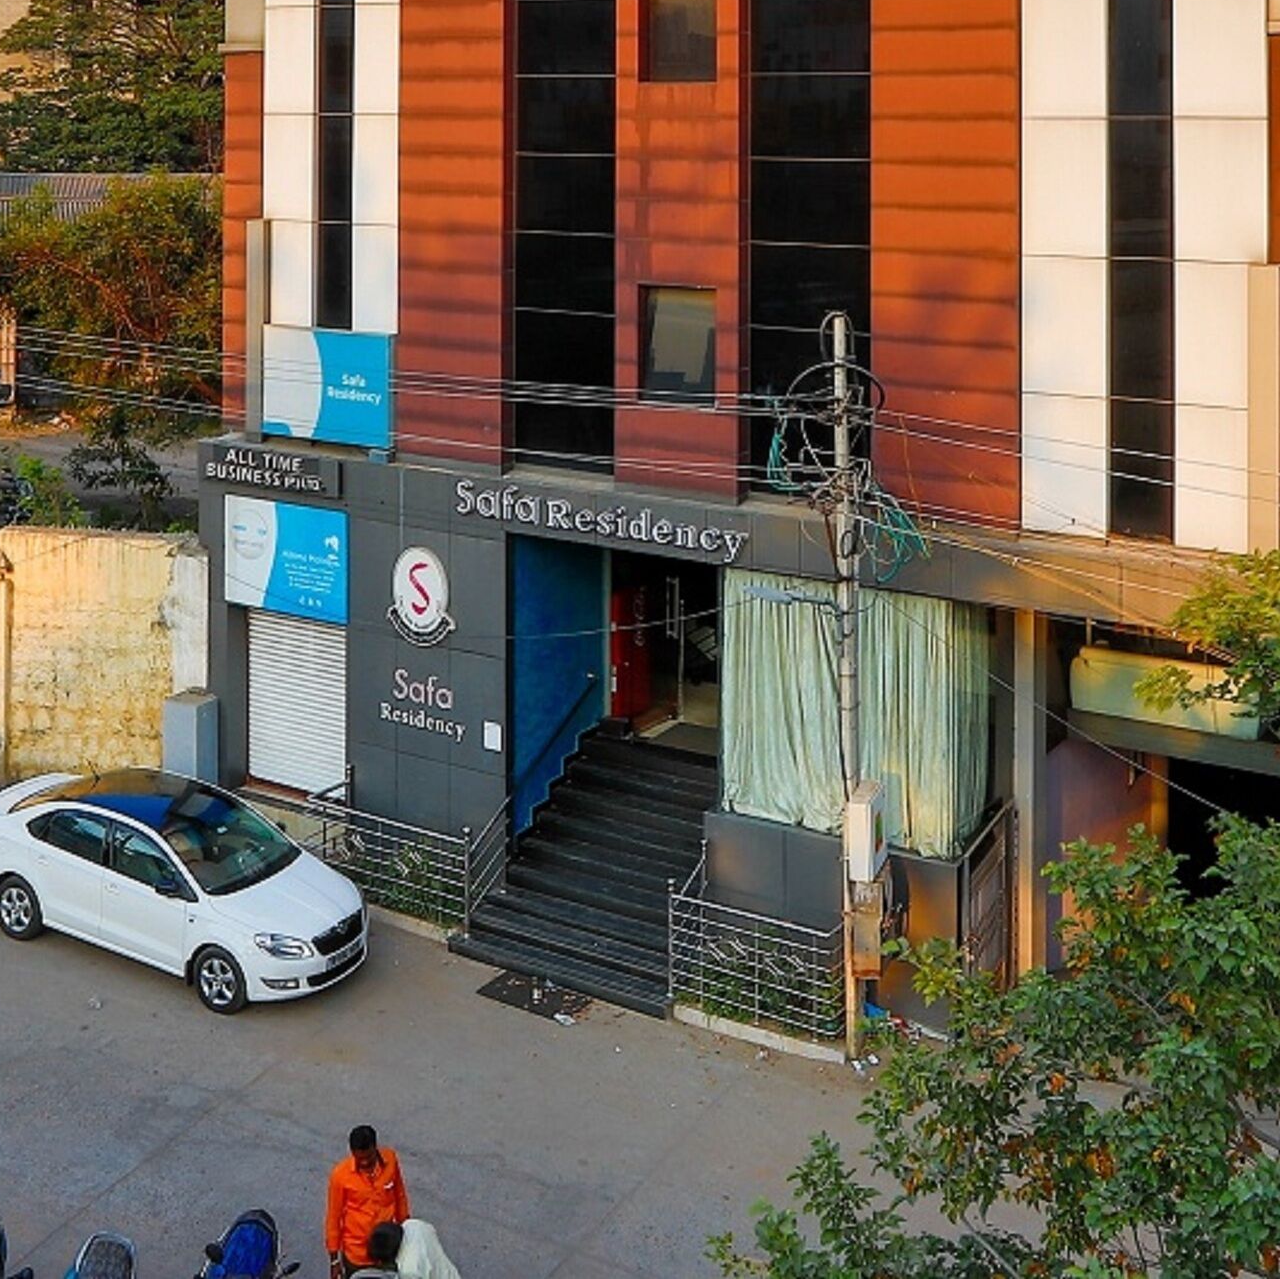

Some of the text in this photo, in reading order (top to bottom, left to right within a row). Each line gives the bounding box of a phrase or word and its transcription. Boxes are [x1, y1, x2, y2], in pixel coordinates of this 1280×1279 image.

[341, 373, 367, 388] Safa
[326, 386, 383, 406] Residency
[225, 448, 303, 472] ALL TIME
[205, 462, 282, 487] BUSINESS
[455, 478, 750, 562] Safa Residency
[392, 668, 455, 711] Safa
[379, 702, 467, 743] Residency
